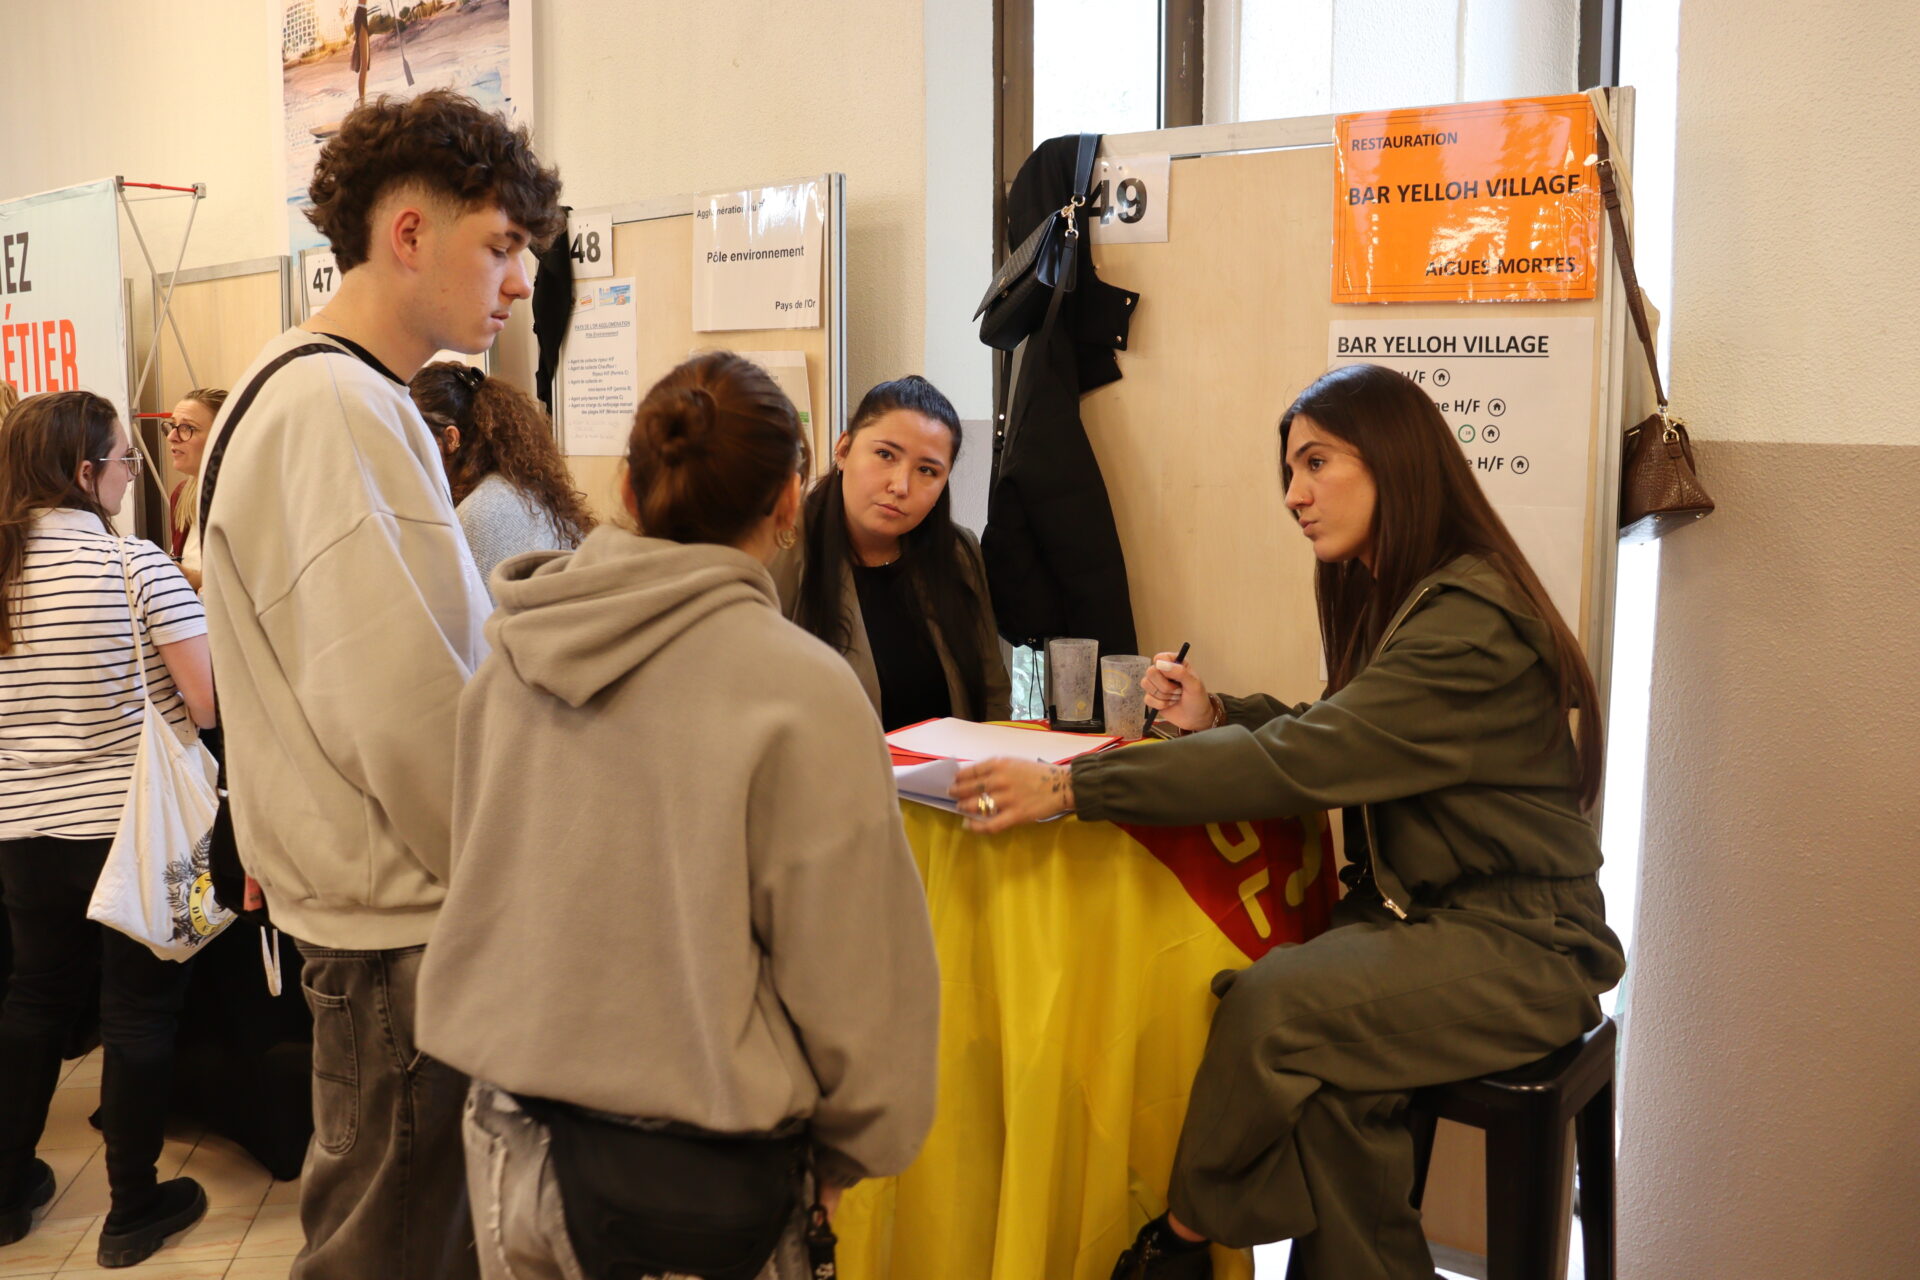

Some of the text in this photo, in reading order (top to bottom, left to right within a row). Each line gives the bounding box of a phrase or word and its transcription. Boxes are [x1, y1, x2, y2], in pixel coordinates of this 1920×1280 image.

[1351, 131, 1458, 152] RESTAURATION
[1348, 174, 1581, 206] BAR YELLOH VILLAGE
[1088, 177, 1148, 225] 49
[696, 204, 744, 220] Agglmératio
[570, 231, 601, 264] 48
[706, 245, 805, 264] Pôle environnement
[0, 231, 32, 296] EZ
[313, 266, 334, 293] 47
[775, 298, 816, 312] Pays de l'Or
[1337, 335, 1549, 353] BAR YELLOH VILLAGE
[1454, 399, 1481, 415] H/F
[1477, 455, 1504, 472] H/F
